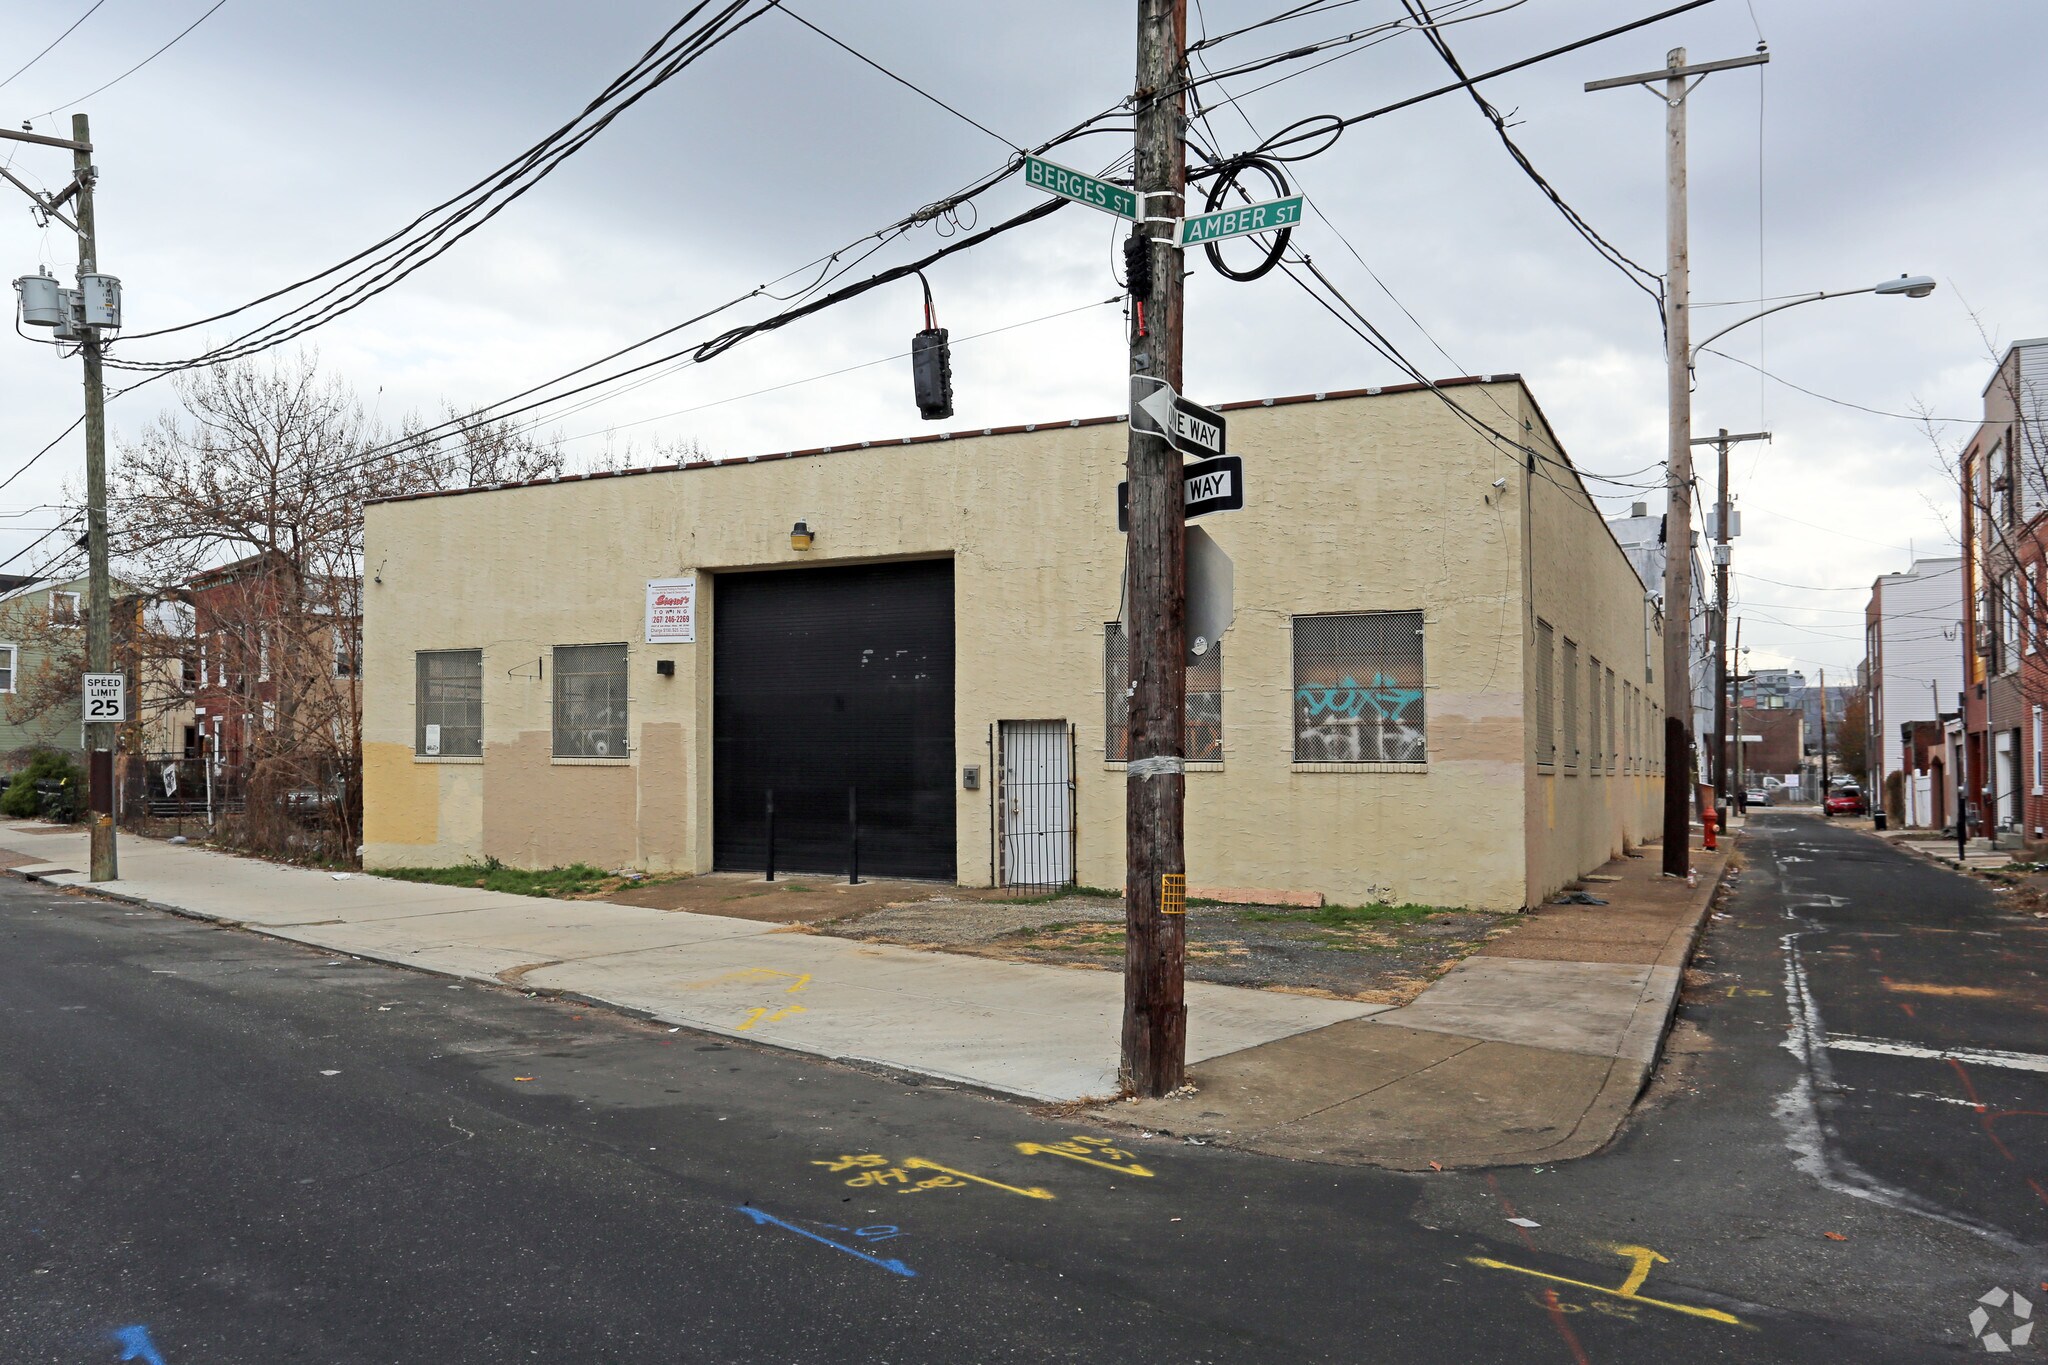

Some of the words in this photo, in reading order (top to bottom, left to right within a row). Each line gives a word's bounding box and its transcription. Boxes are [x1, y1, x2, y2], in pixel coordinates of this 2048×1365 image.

[1030, 159, 1107, 206] BERGES
[1113, 194, 1131, 214] ST
[1188, 206, 1266, 241] AMBER
[1275, 203, 1298, 224] ST
[1189, 418, 1217, 447] WAY
[1189, 473, 1225, 501] WAY
[87, 679, 121, 687] SPEED
[91, 689, 117, 697] LIMIT
[90, 699, 120, 716] 25
